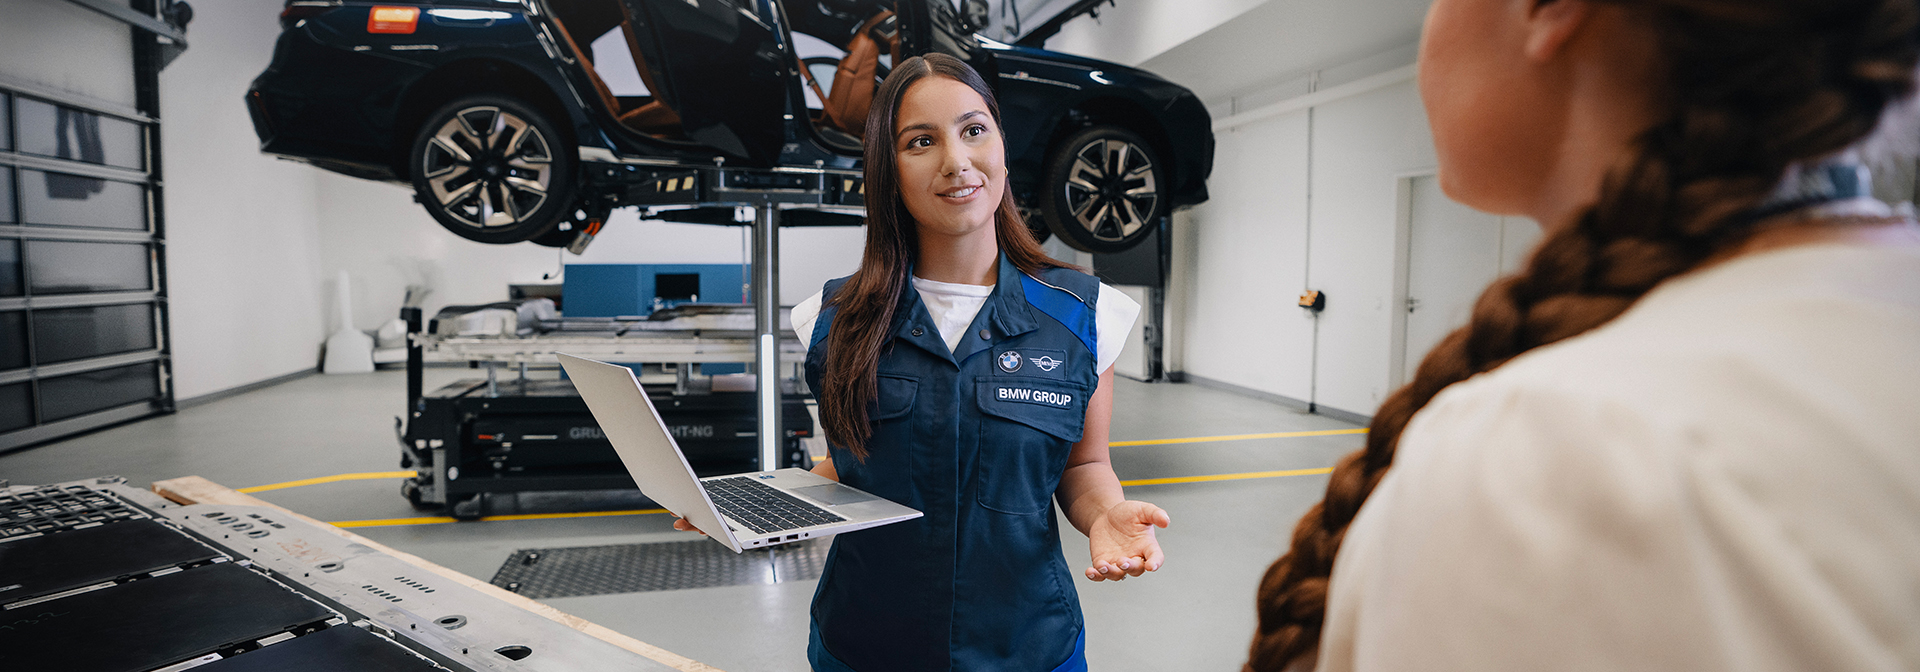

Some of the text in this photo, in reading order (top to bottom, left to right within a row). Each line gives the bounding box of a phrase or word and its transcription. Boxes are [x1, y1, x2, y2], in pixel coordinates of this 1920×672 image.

[999, 388, 1072, 406] BMW GROUP
[569, 425, 714, 440] GRU HT-NG
